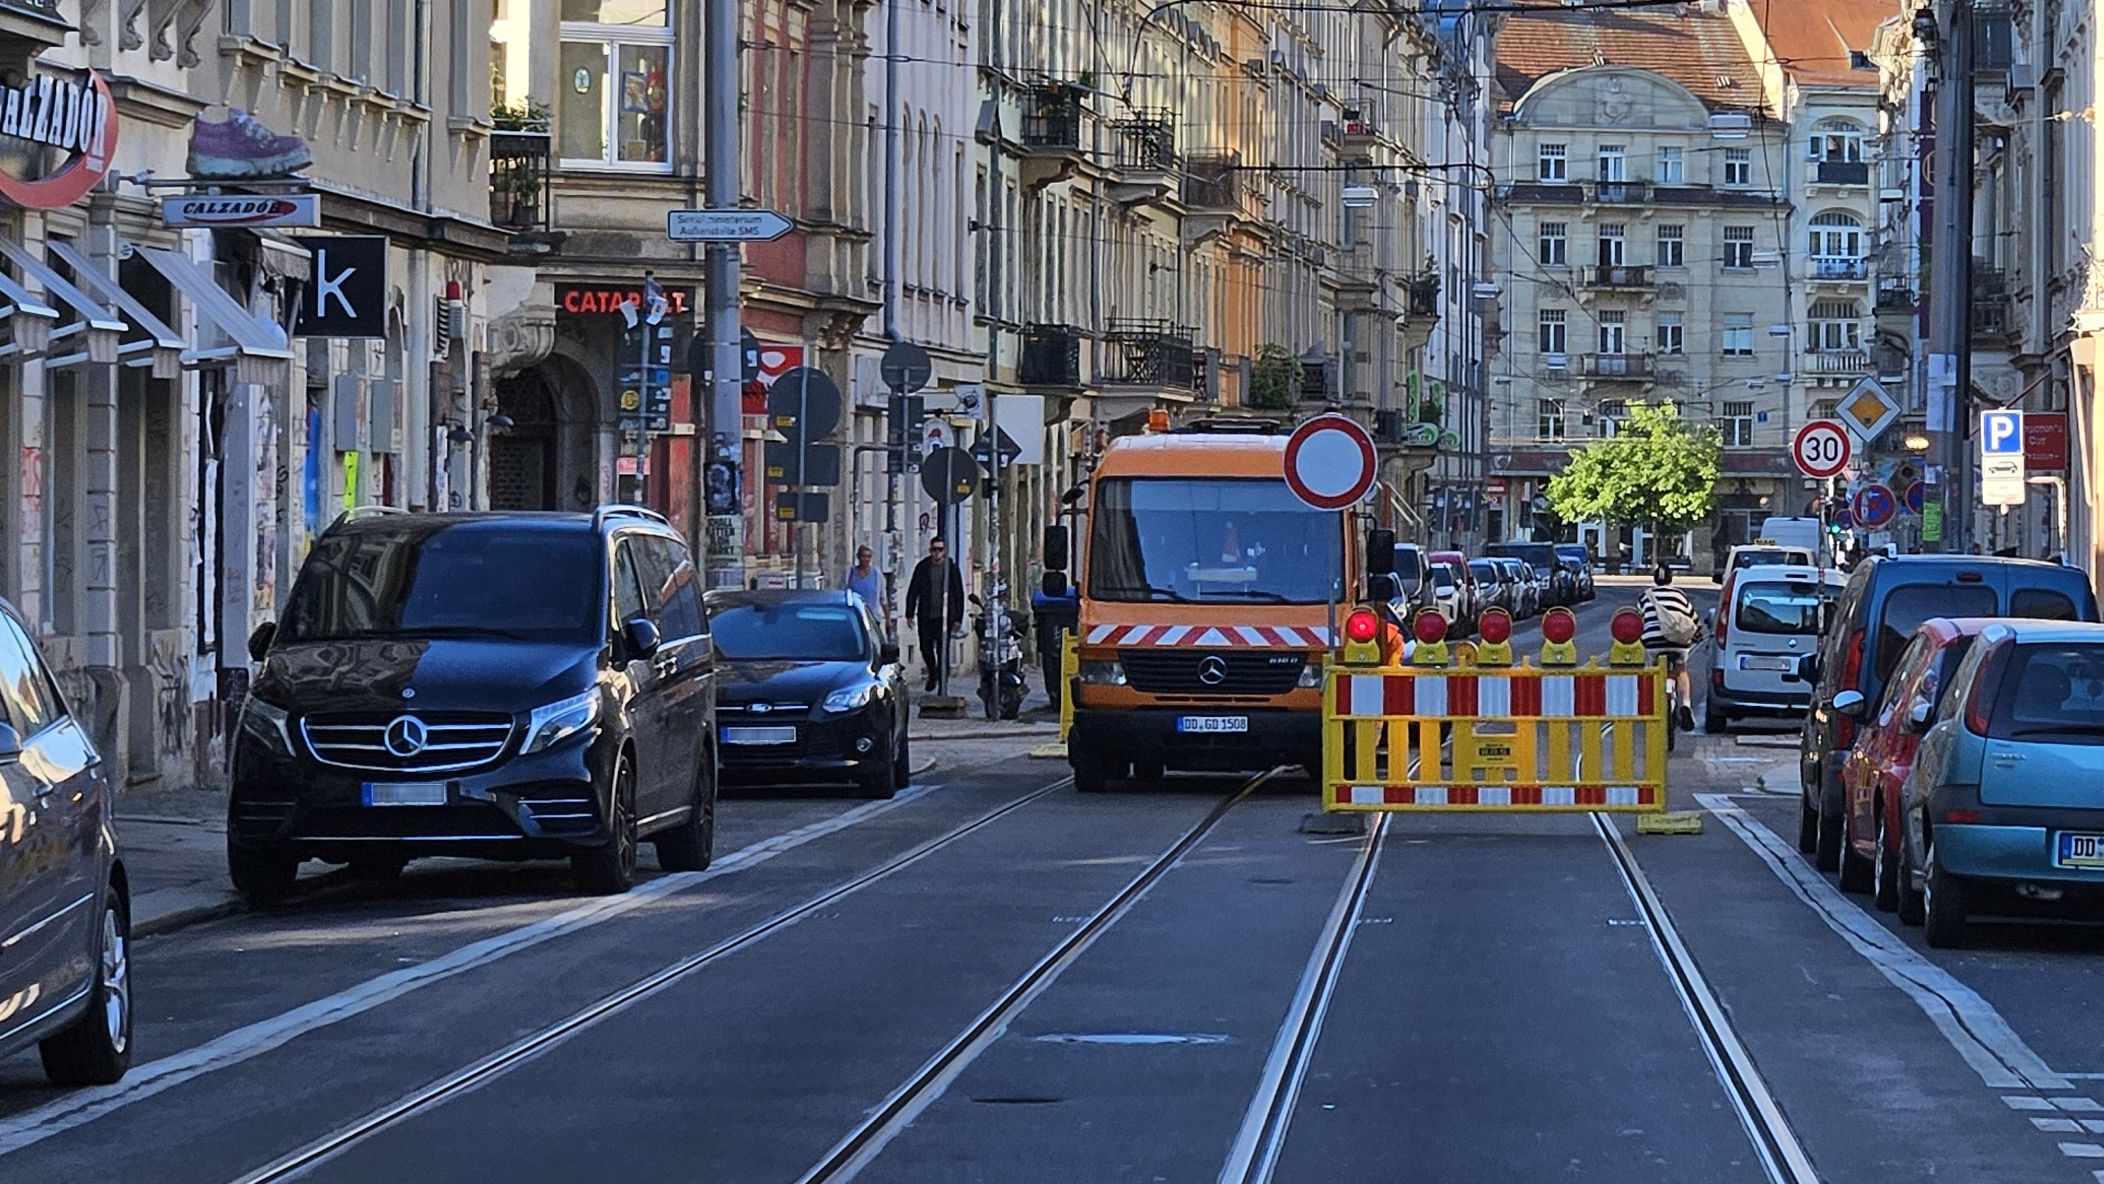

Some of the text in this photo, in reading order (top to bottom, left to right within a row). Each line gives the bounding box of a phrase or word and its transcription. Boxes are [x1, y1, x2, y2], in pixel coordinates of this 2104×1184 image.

[0, 74, 108, 157] ALZADÓR
[738, 226, 760, 236] SMS
[1990, 416, 2015, 450] P
[1805, 436, 1838, 462] 30
[1184, 718, 1198, 730] DD
[1221, 718, 1247, 730] 1508
[2073, 837, 2096, 857] DD
